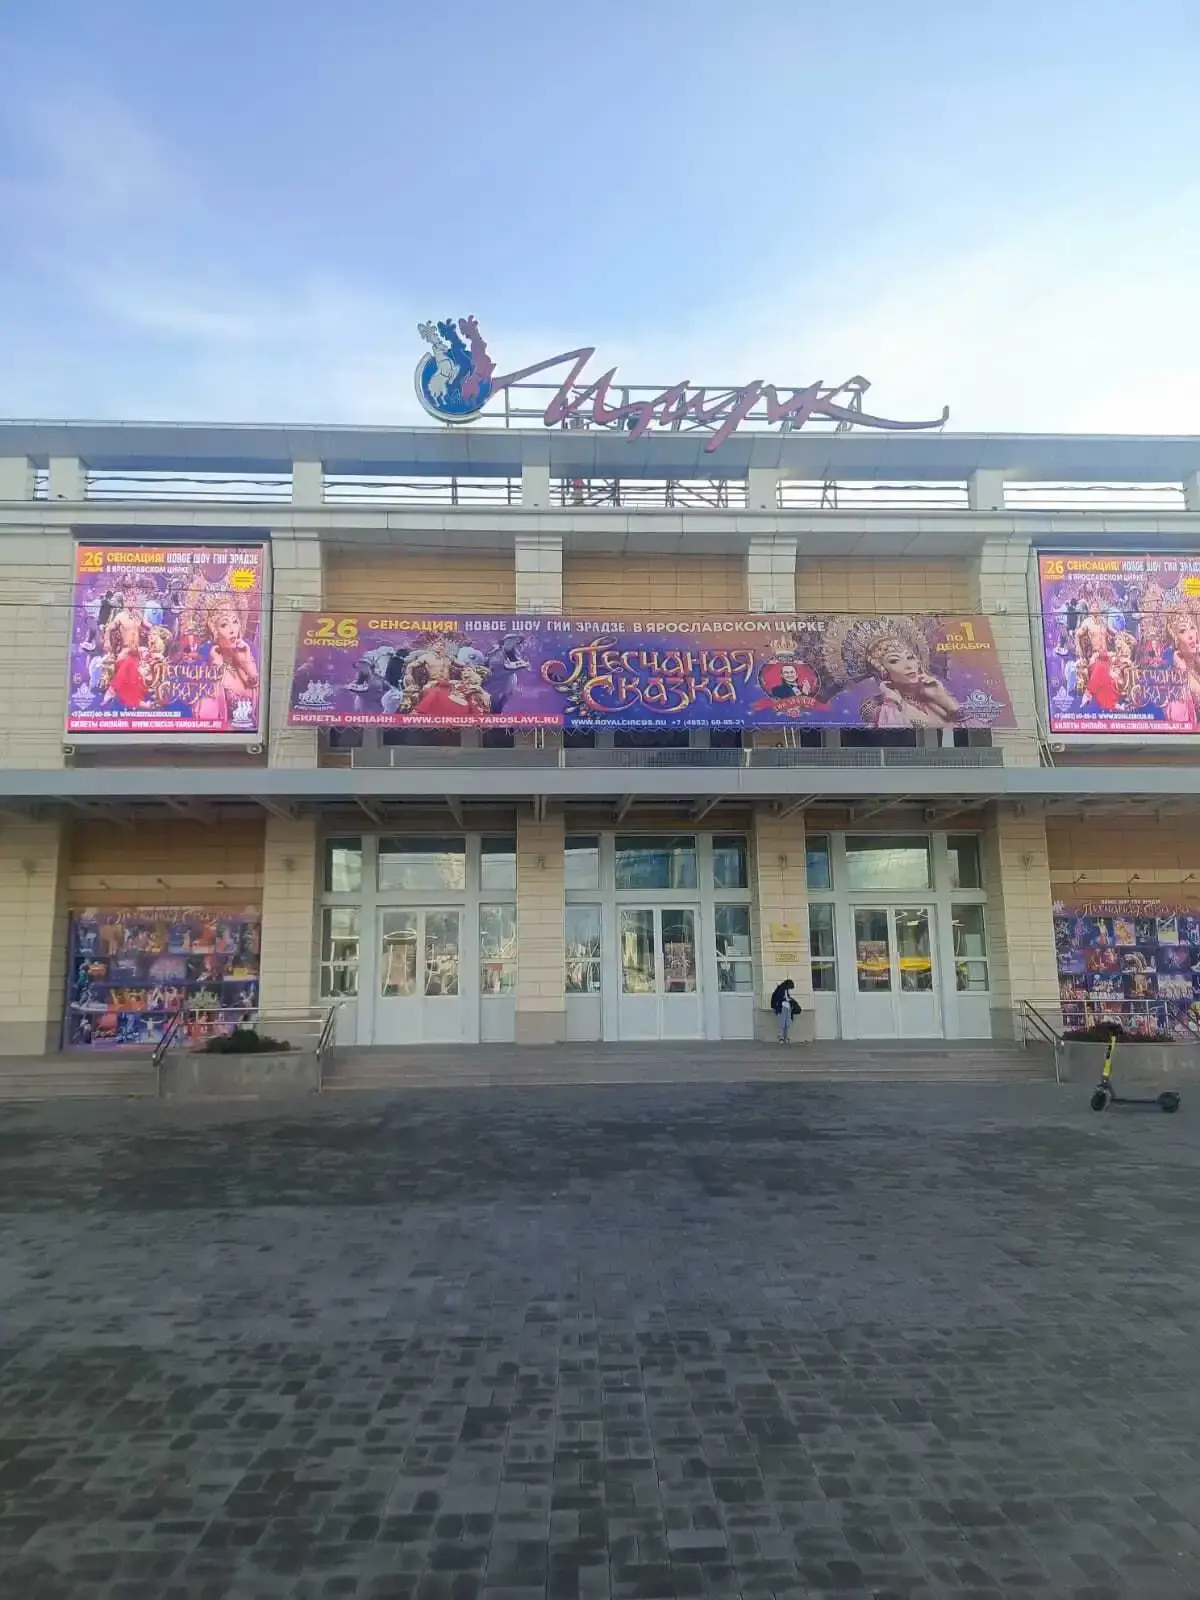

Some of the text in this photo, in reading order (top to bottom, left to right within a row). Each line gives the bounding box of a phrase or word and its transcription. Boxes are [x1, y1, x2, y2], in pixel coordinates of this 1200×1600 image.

[84, 552, 103, 566] 26
[106, 552, 165, 565] СЕНСАЦИЯ!
[1045, 561, 1065, 575] 26
[316, 617, 358, 639] 26
[367, 619, 826, 633] СЕНСАЦИЯ! НОВОЕ ШОУ ГИИ ЭРАДЗЕ В ЯРОСЛАВСКОМ ЦИРКЕ
[960, 622, 975, 641] 1
[303, 638, 359, 648] ОКТЯБРЯ
[936, 642, 991, 652] ДЕКАБРЯ
[292, 714, 341, 723] БИЛЕТЫ
